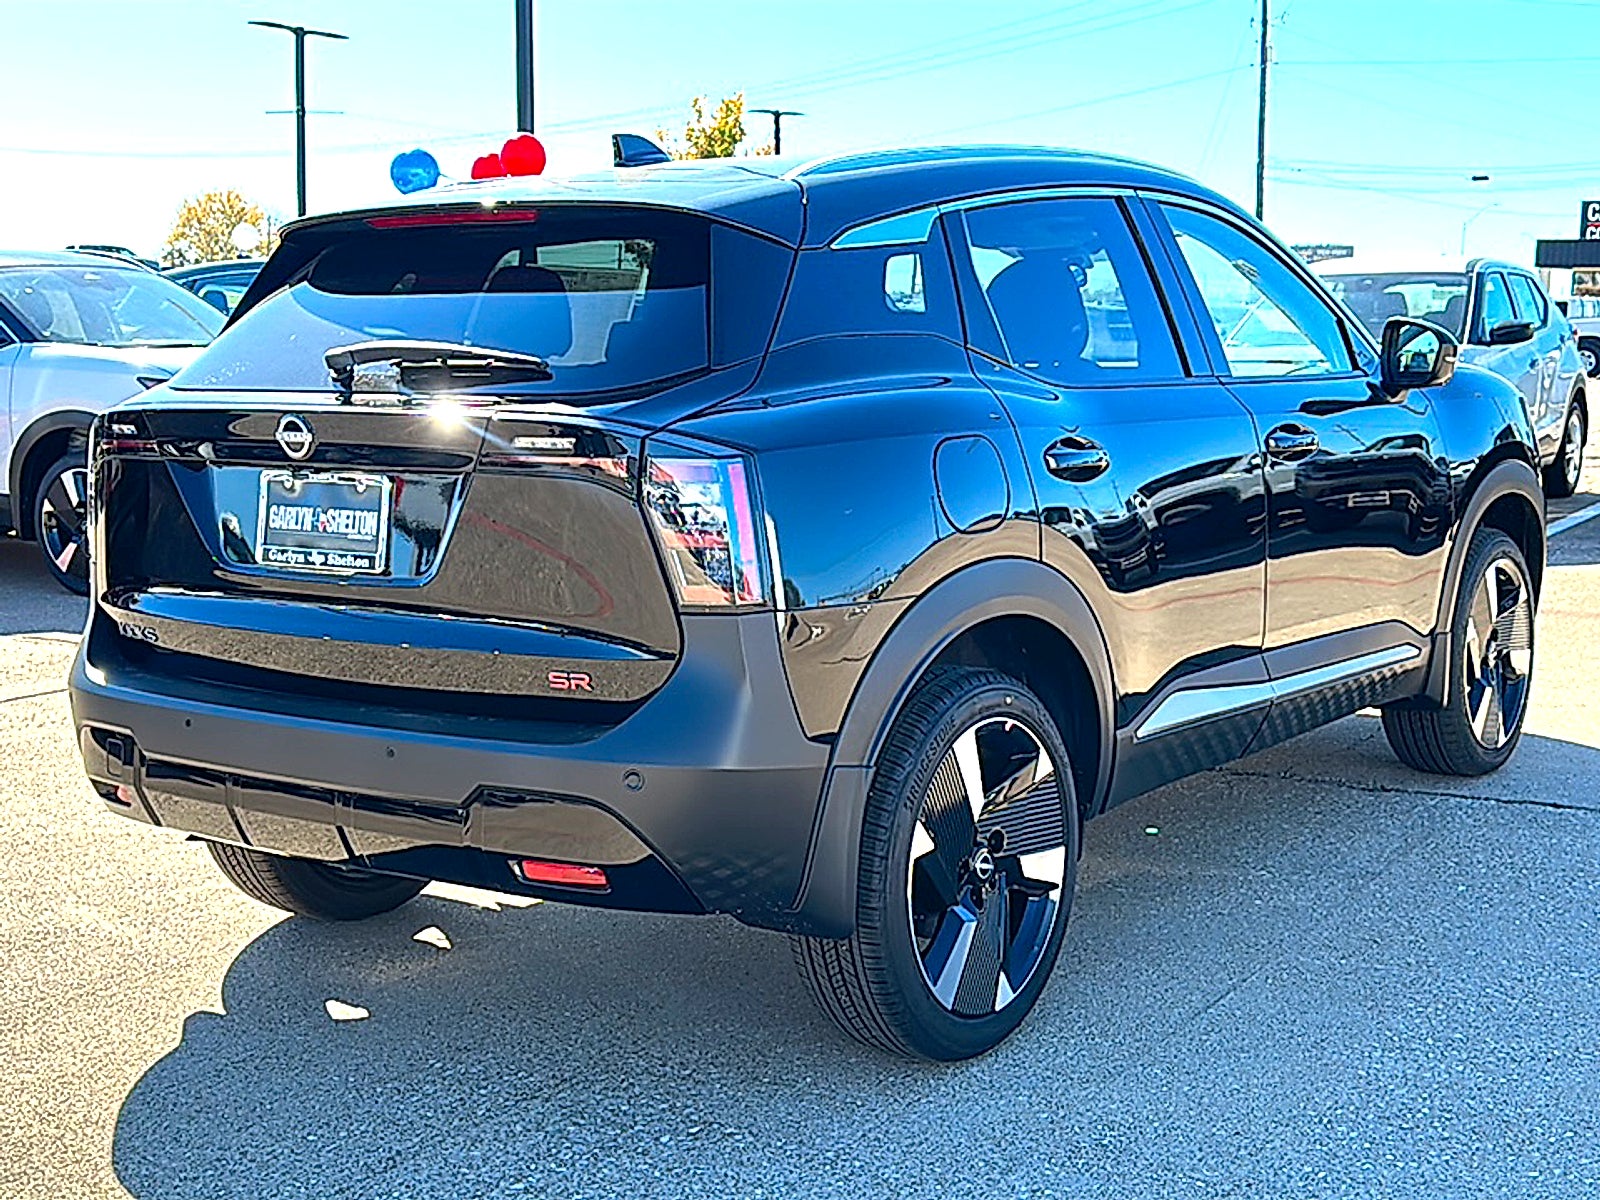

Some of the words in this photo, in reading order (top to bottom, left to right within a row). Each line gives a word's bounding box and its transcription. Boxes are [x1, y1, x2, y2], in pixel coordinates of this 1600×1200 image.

[1587, 203, 1600, 221] C
[269, 505, 313, 532] GARLYN
[326, 508, 379, 536] SHELTON
[268, 549, 305, 565] Garlyn
[327, 553, 370, 568] Shelton
[548, 671, 593, 692] SR
